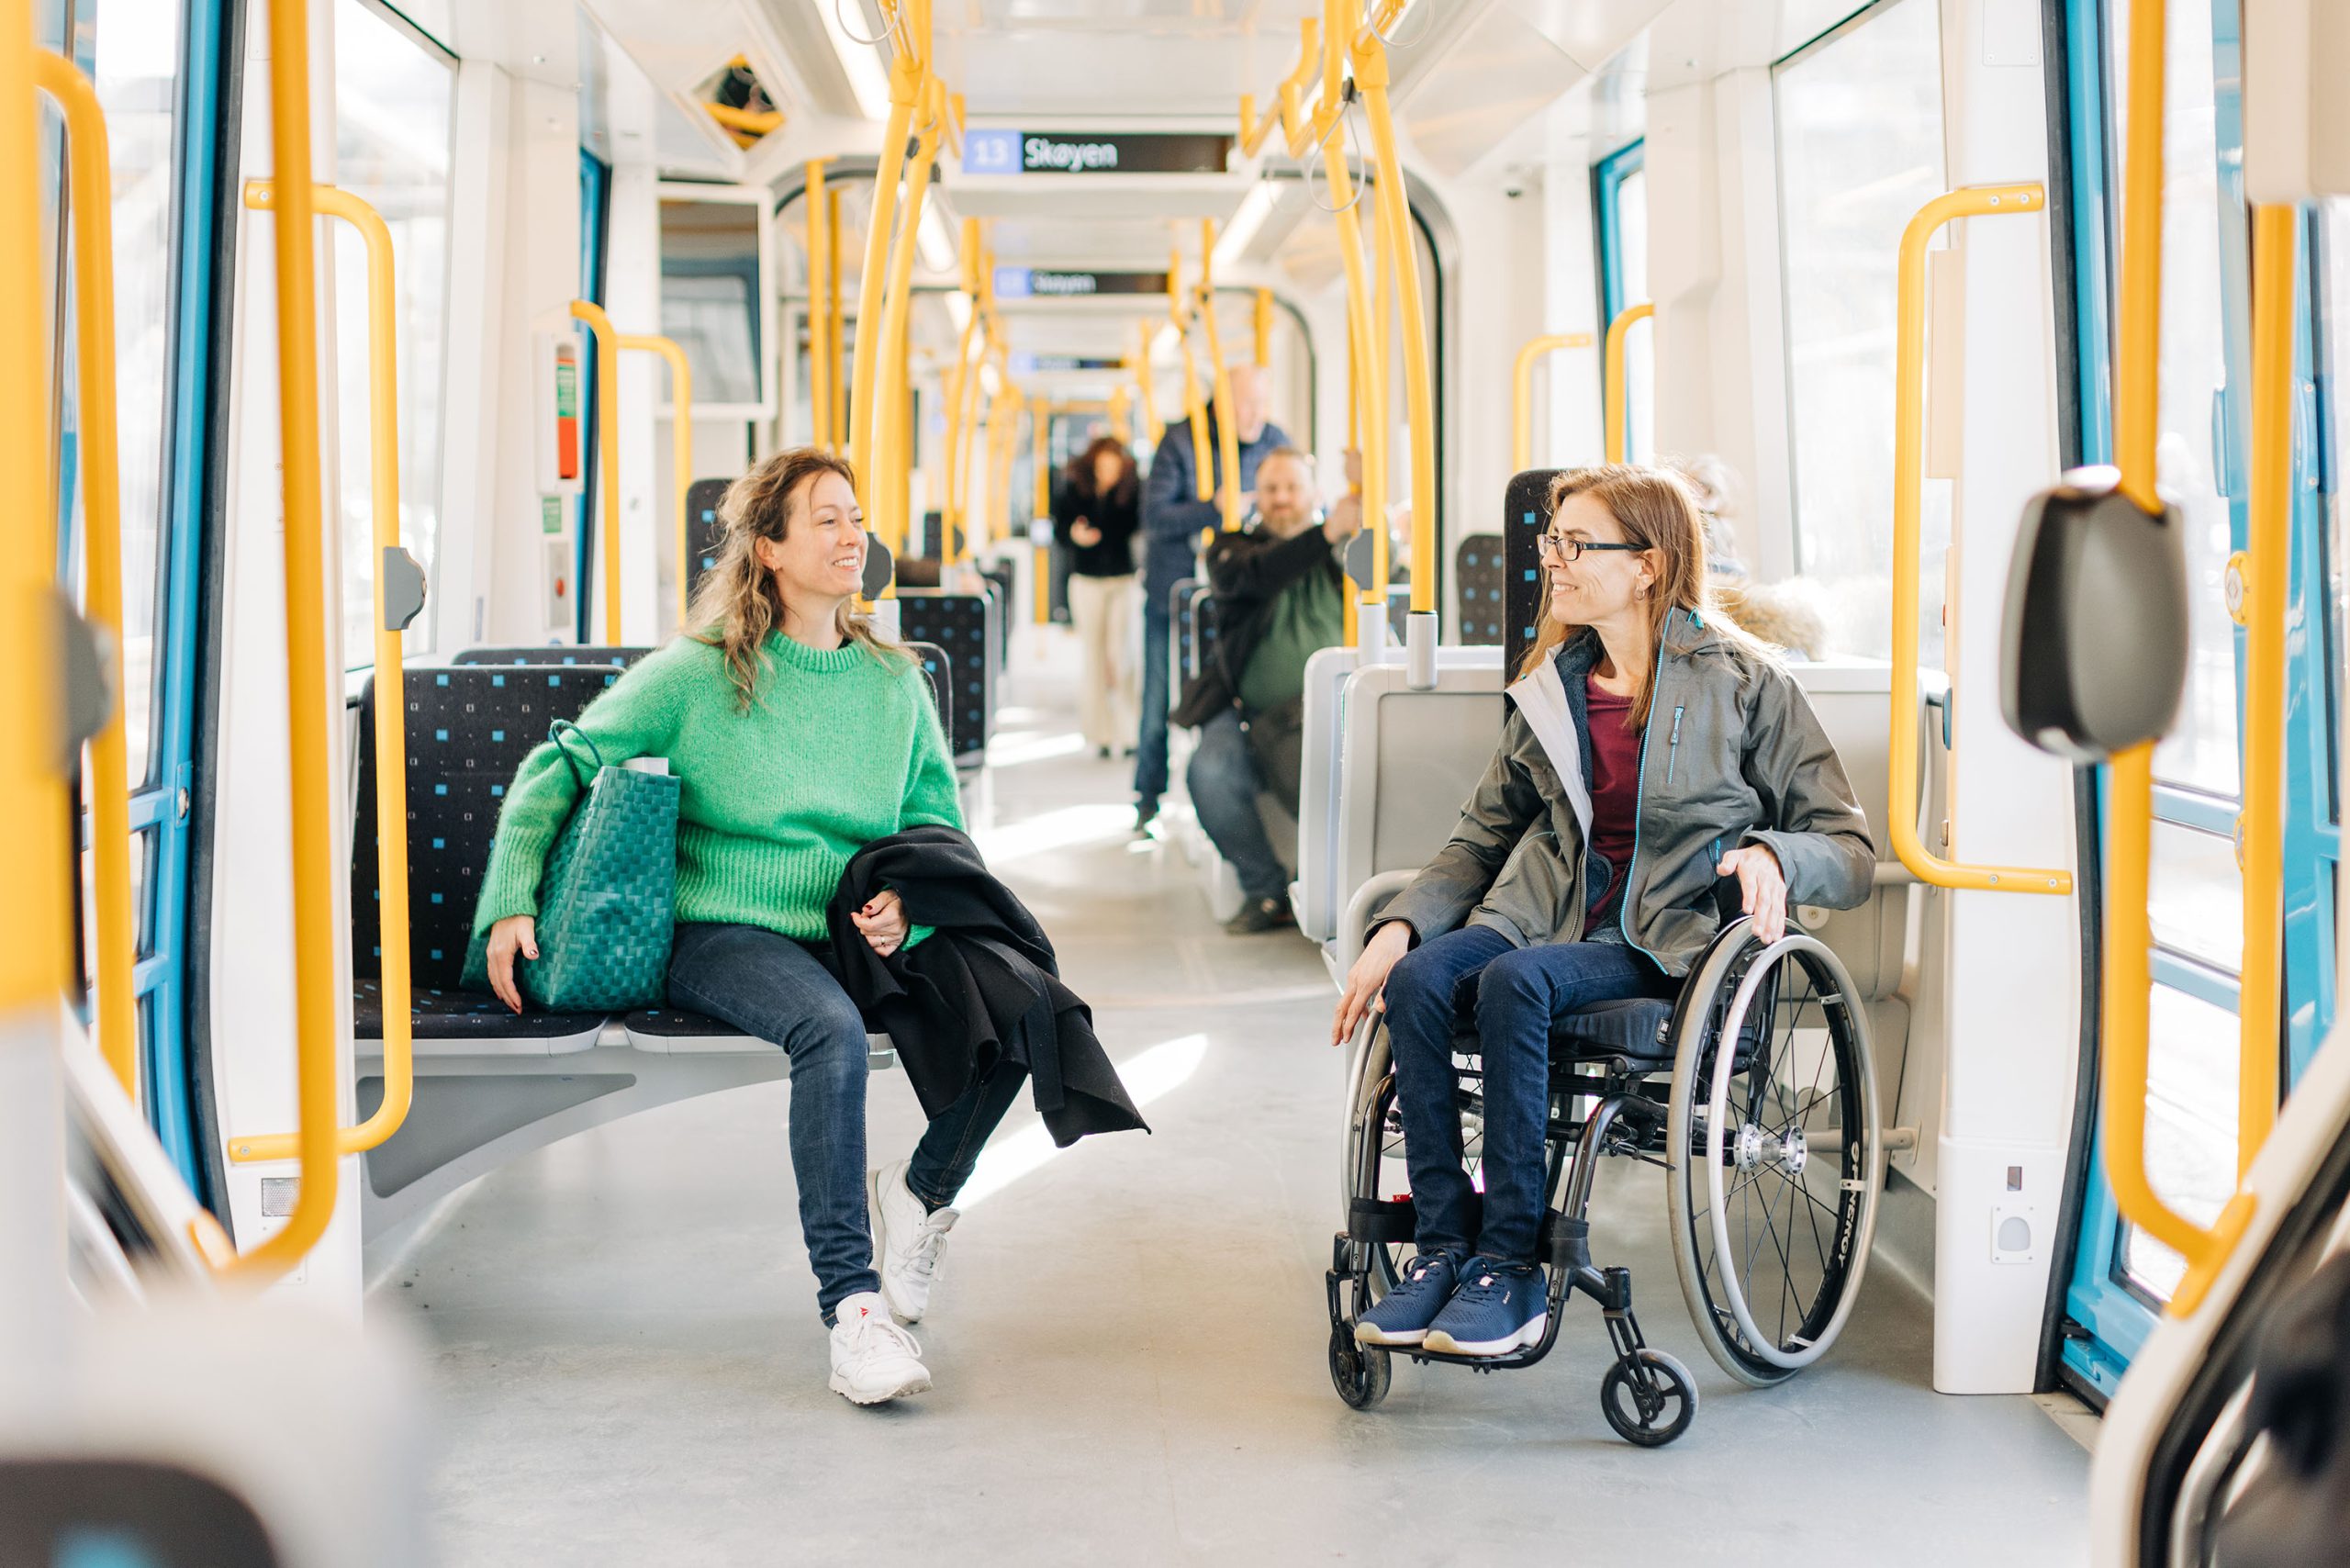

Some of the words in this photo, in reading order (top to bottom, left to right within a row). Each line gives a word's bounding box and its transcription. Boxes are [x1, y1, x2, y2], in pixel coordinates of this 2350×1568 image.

[973, 138, 1009, 166] 13
[1024, 138, 1119, 173] Skøyen
[1838, 1140, 1860, 1269] SPNERGY
